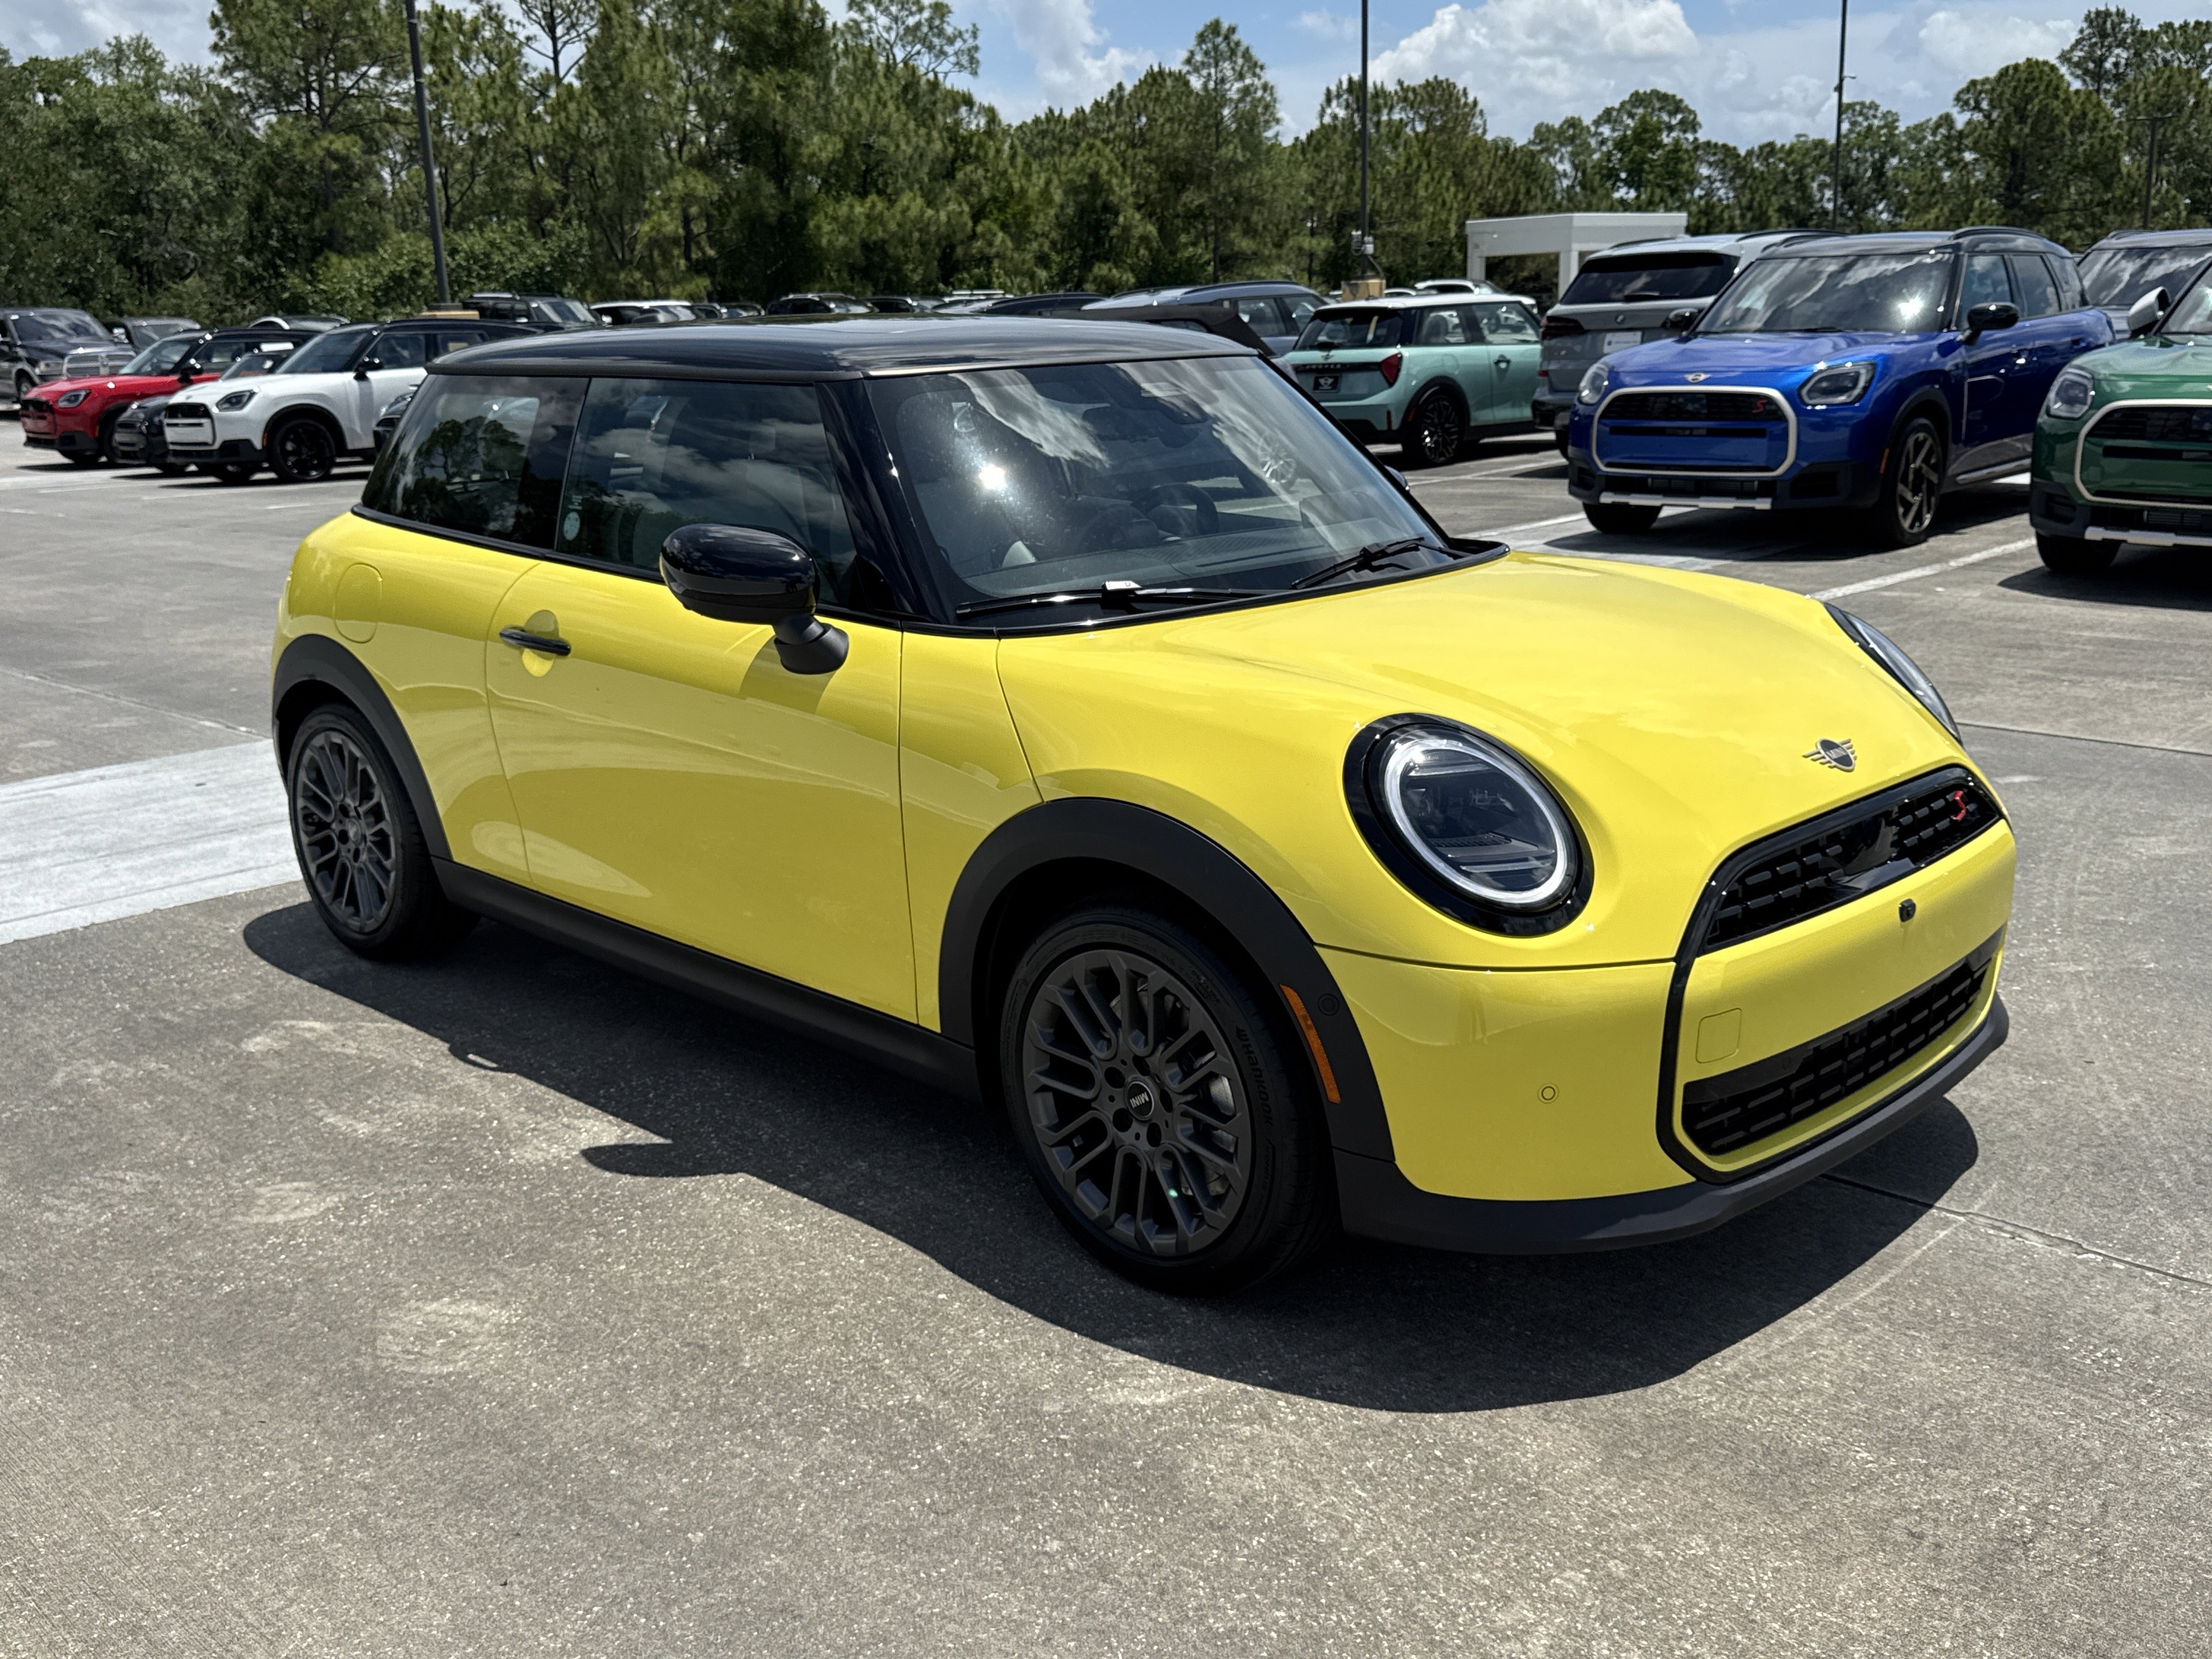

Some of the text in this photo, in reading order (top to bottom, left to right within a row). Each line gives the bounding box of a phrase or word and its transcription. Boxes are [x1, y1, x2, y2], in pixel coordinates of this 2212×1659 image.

[1751, 398, 1768, 413] S
[1825, 747, 1848, 760] MINI
[1130, 1091, 1149, 1109] MINI
